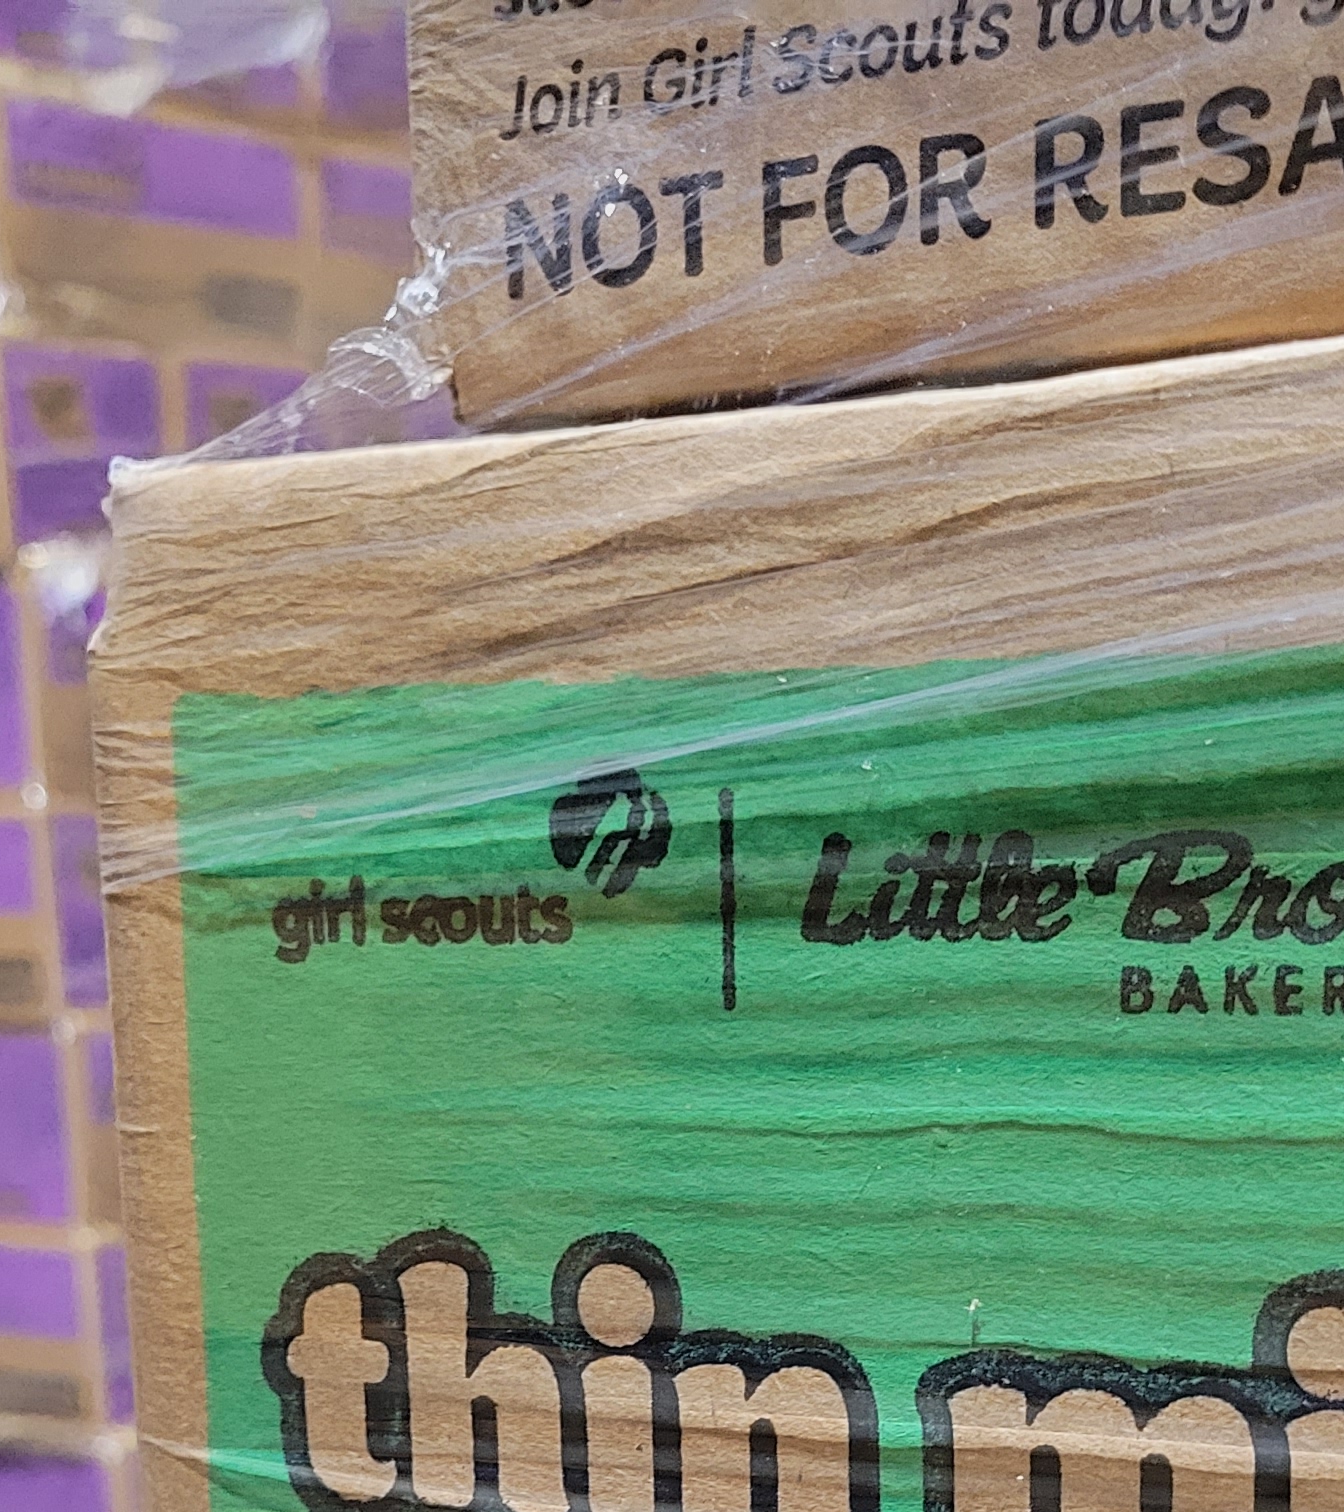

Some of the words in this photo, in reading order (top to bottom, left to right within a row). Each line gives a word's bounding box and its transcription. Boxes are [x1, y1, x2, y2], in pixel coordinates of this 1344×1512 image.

[499, 58, 622, 141] Join
[642, 25, 756, 114] Girl
[770, 2, 1013, 95] Scouts
[1037, 0, 1274, 51] today
[503, 169, 724, 301] NOT
[762, 130, 993, 267] FOR
[271, 873, 367, 965] girl
[379, 883, 574, 948] scouts
[800, 830, 1078, 946] Little
